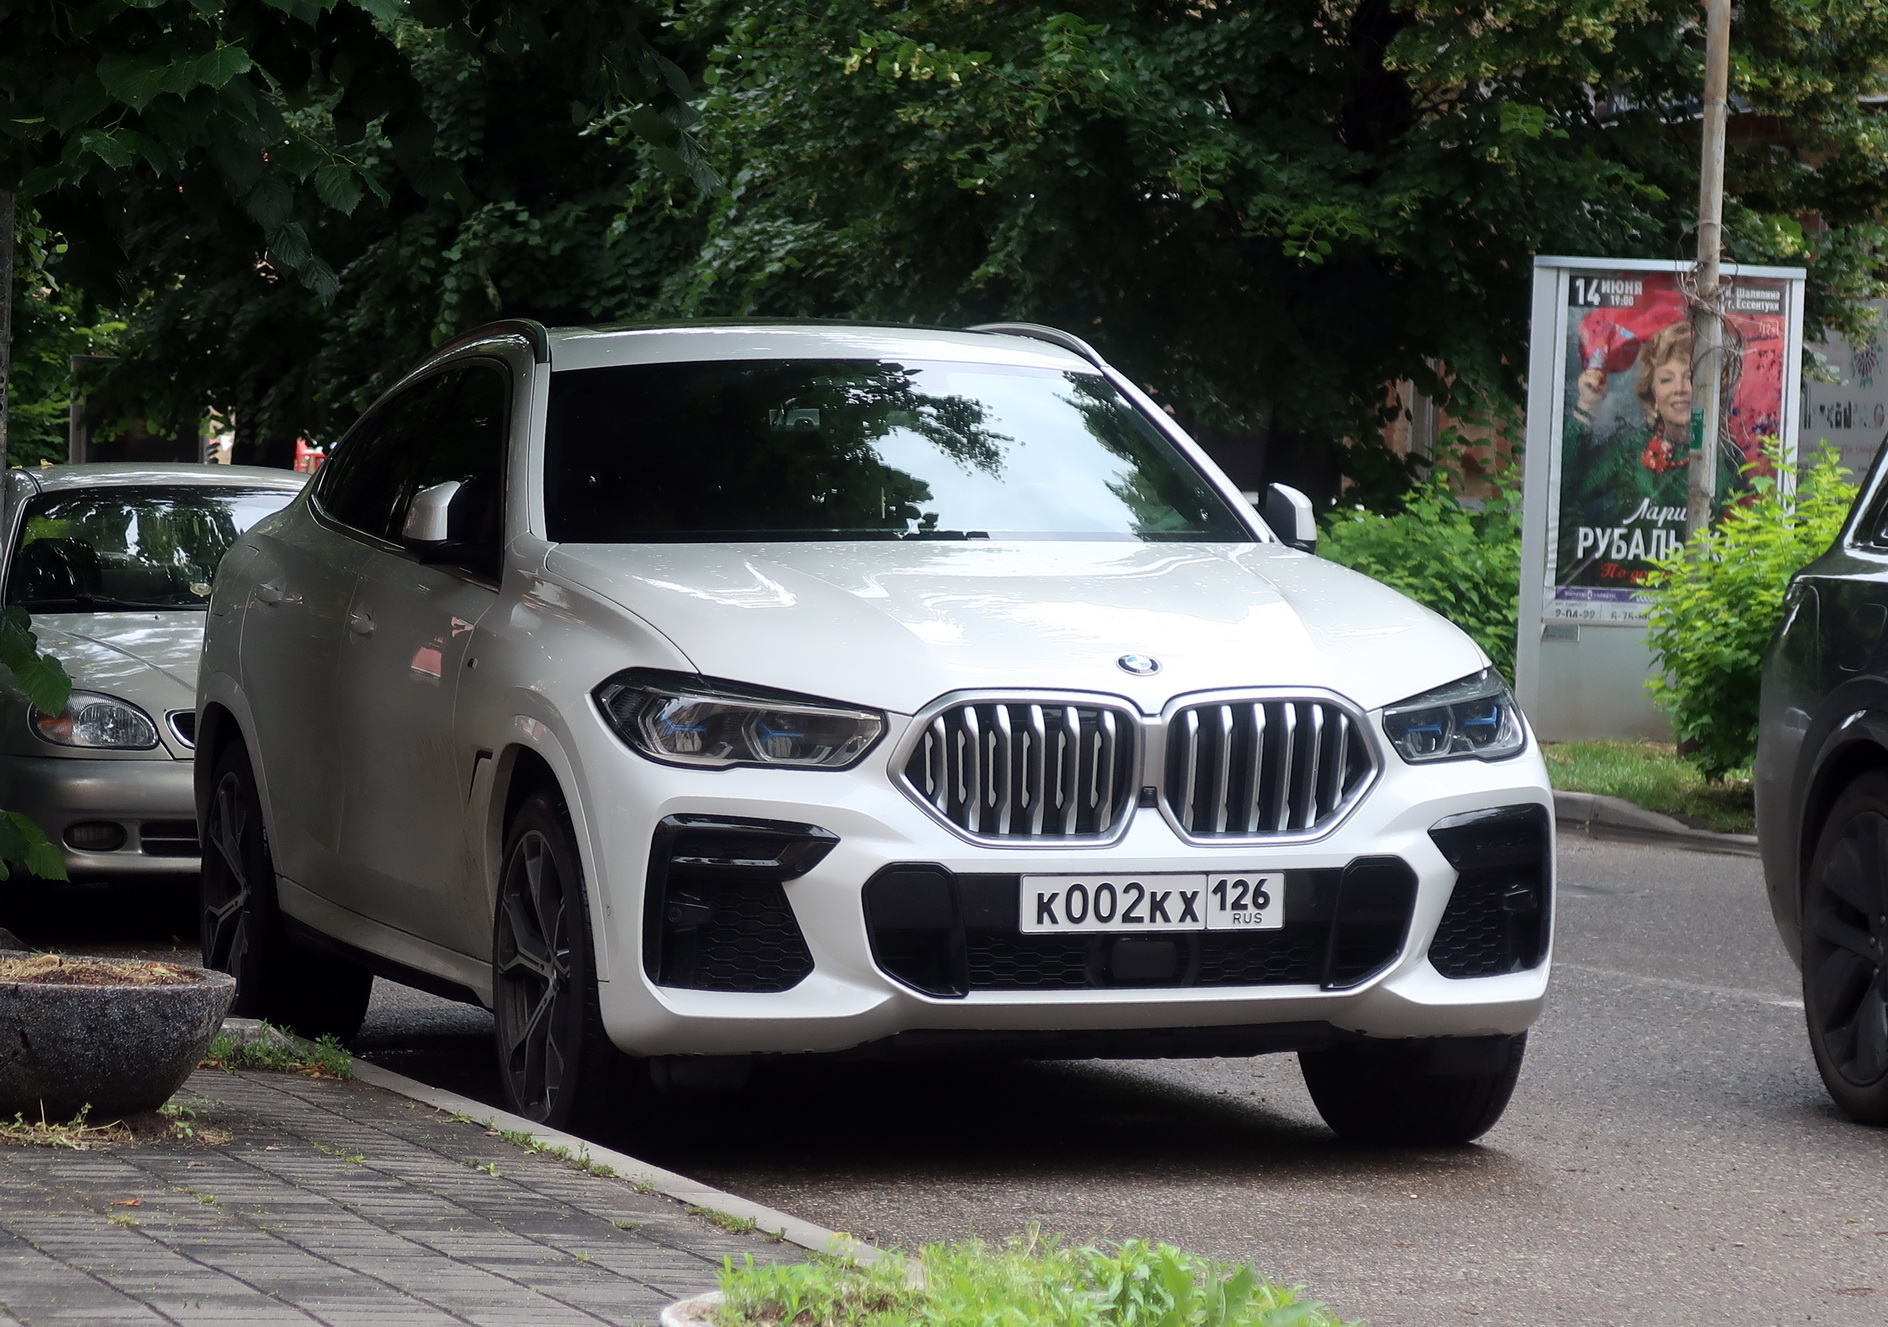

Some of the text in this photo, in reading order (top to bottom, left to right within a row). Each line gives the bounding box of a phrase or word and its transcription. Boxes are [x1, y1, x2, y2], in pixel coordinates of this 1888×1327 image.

[1576, 278, 1642, 305] 14 ИЮНЯ
[1736, 287, 1781, 301] Шаляпина
[1611, 295, 1634, 306] 19:00
[1736, 299, 1780, 312] Ессентуки
[1622, 497, 1715, 526] Лари
[1211, 878, 1271, 912] 126
[1232, 912, 1263, 925] RUS
